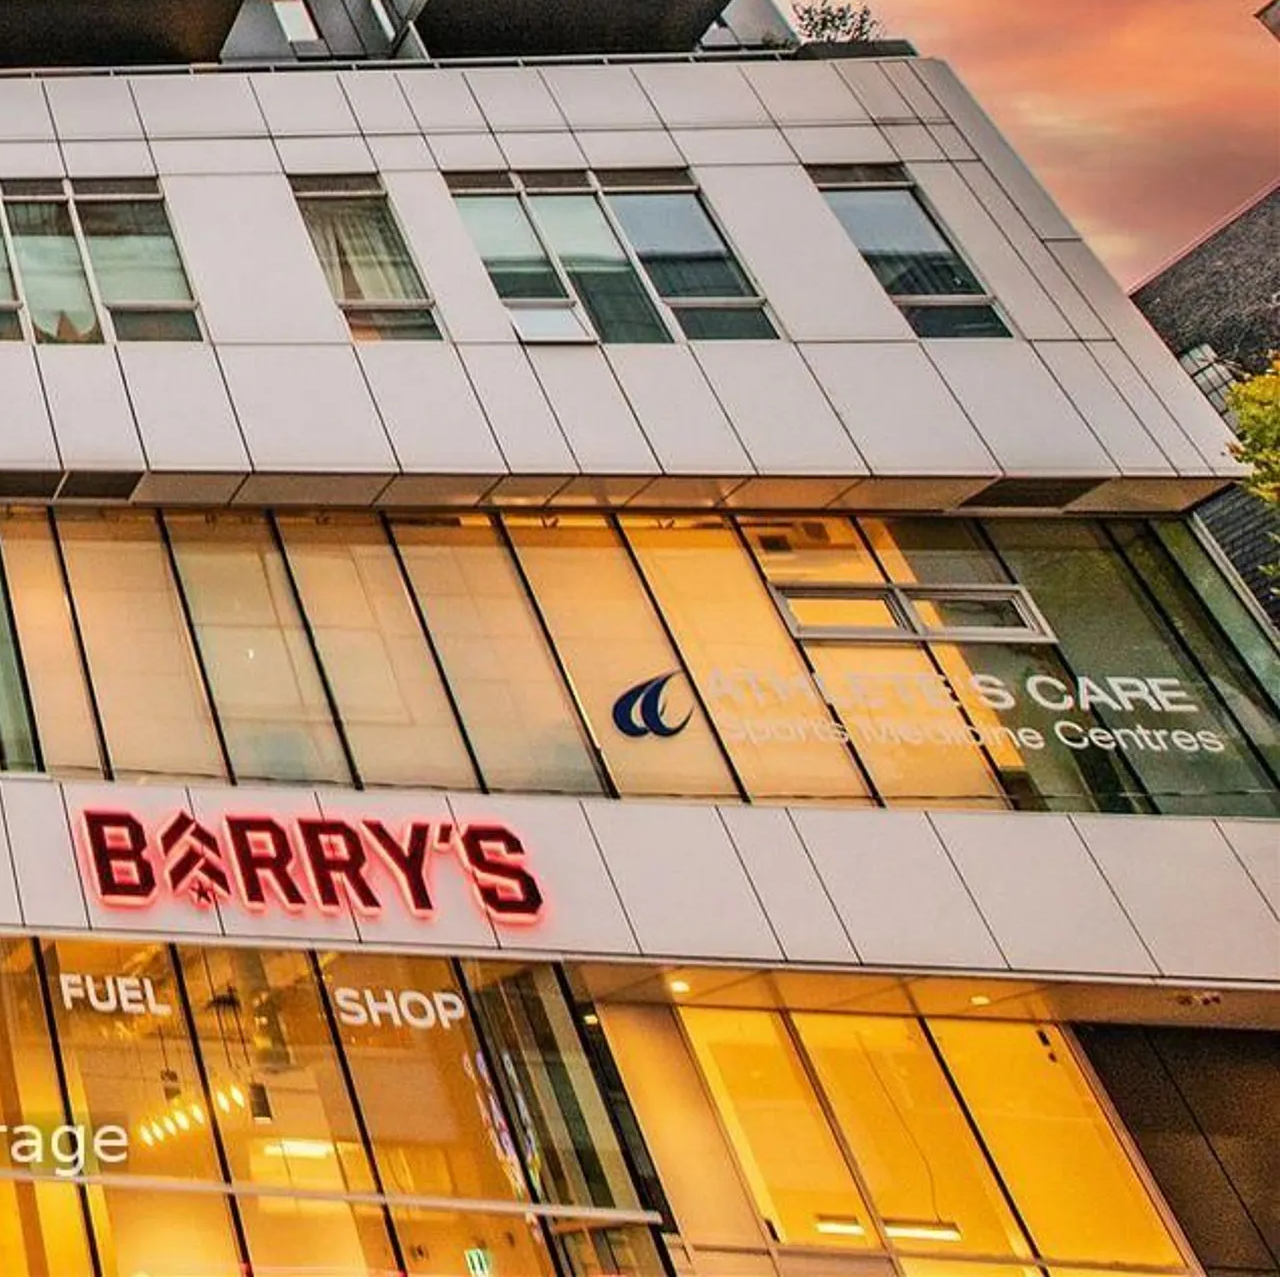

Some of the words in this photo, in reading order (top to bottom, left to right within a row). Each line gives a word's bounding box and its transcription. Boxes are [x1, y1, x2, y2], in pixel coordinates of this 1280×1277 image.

[1026, 675, 1198, 712] CARE
[857, 719, 1044, 749] Medicine
[1054, 720, 1225, 753] Centres
[82, 809, 544, 922] BARRY'S
[61, 973, 172, 1017] FUEL
[334, 988, 466, 1031] SHOP
